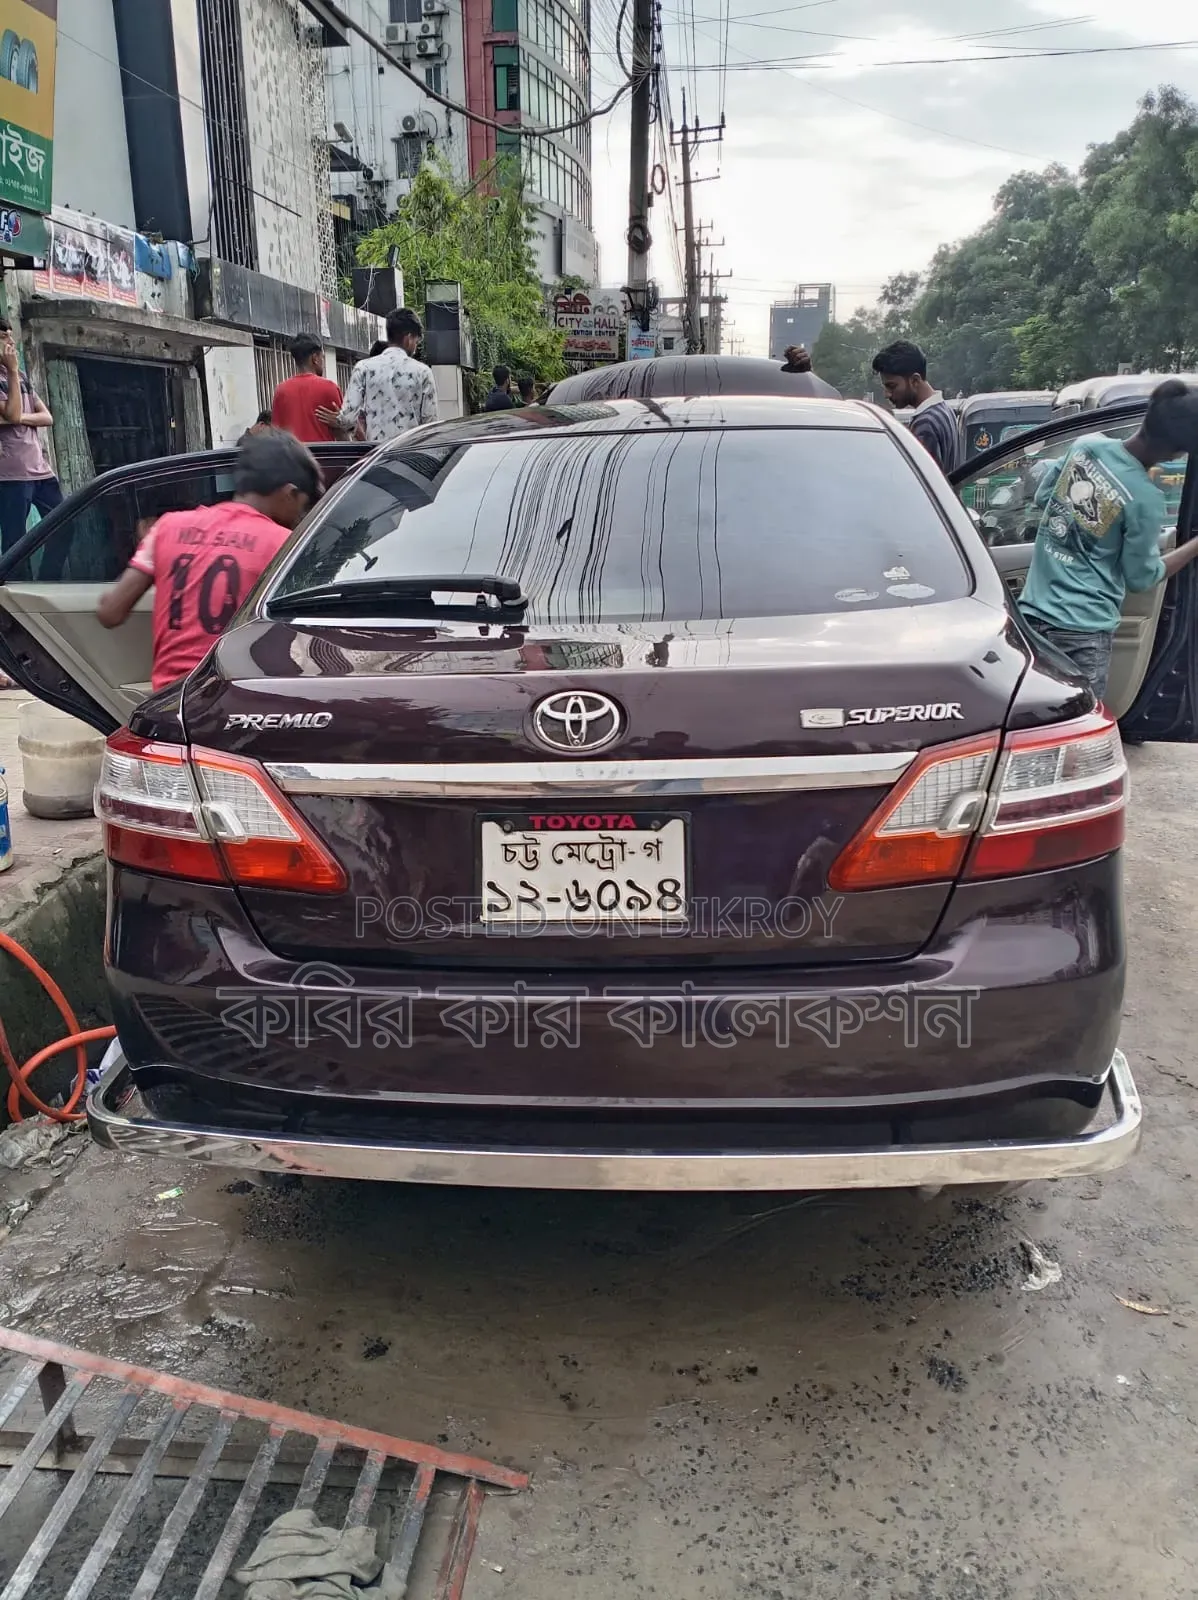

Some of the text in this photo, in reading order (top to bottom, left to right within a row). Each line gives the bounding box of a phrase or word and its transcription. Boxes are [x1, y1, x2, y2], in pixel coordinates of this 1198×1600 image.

[557, 316, 619, 330] CITY HALL
[1053, 551, 1074, 565] STAR
[168, 553, 241, 635] 10
[223, 711, 334, 731] PREMIO
[844, 702, 965, 726] SUPERIOR
[529, 814, 637, 830] TOYOTA
[486, 878, 682, 913] ১২-৬০৯৪
